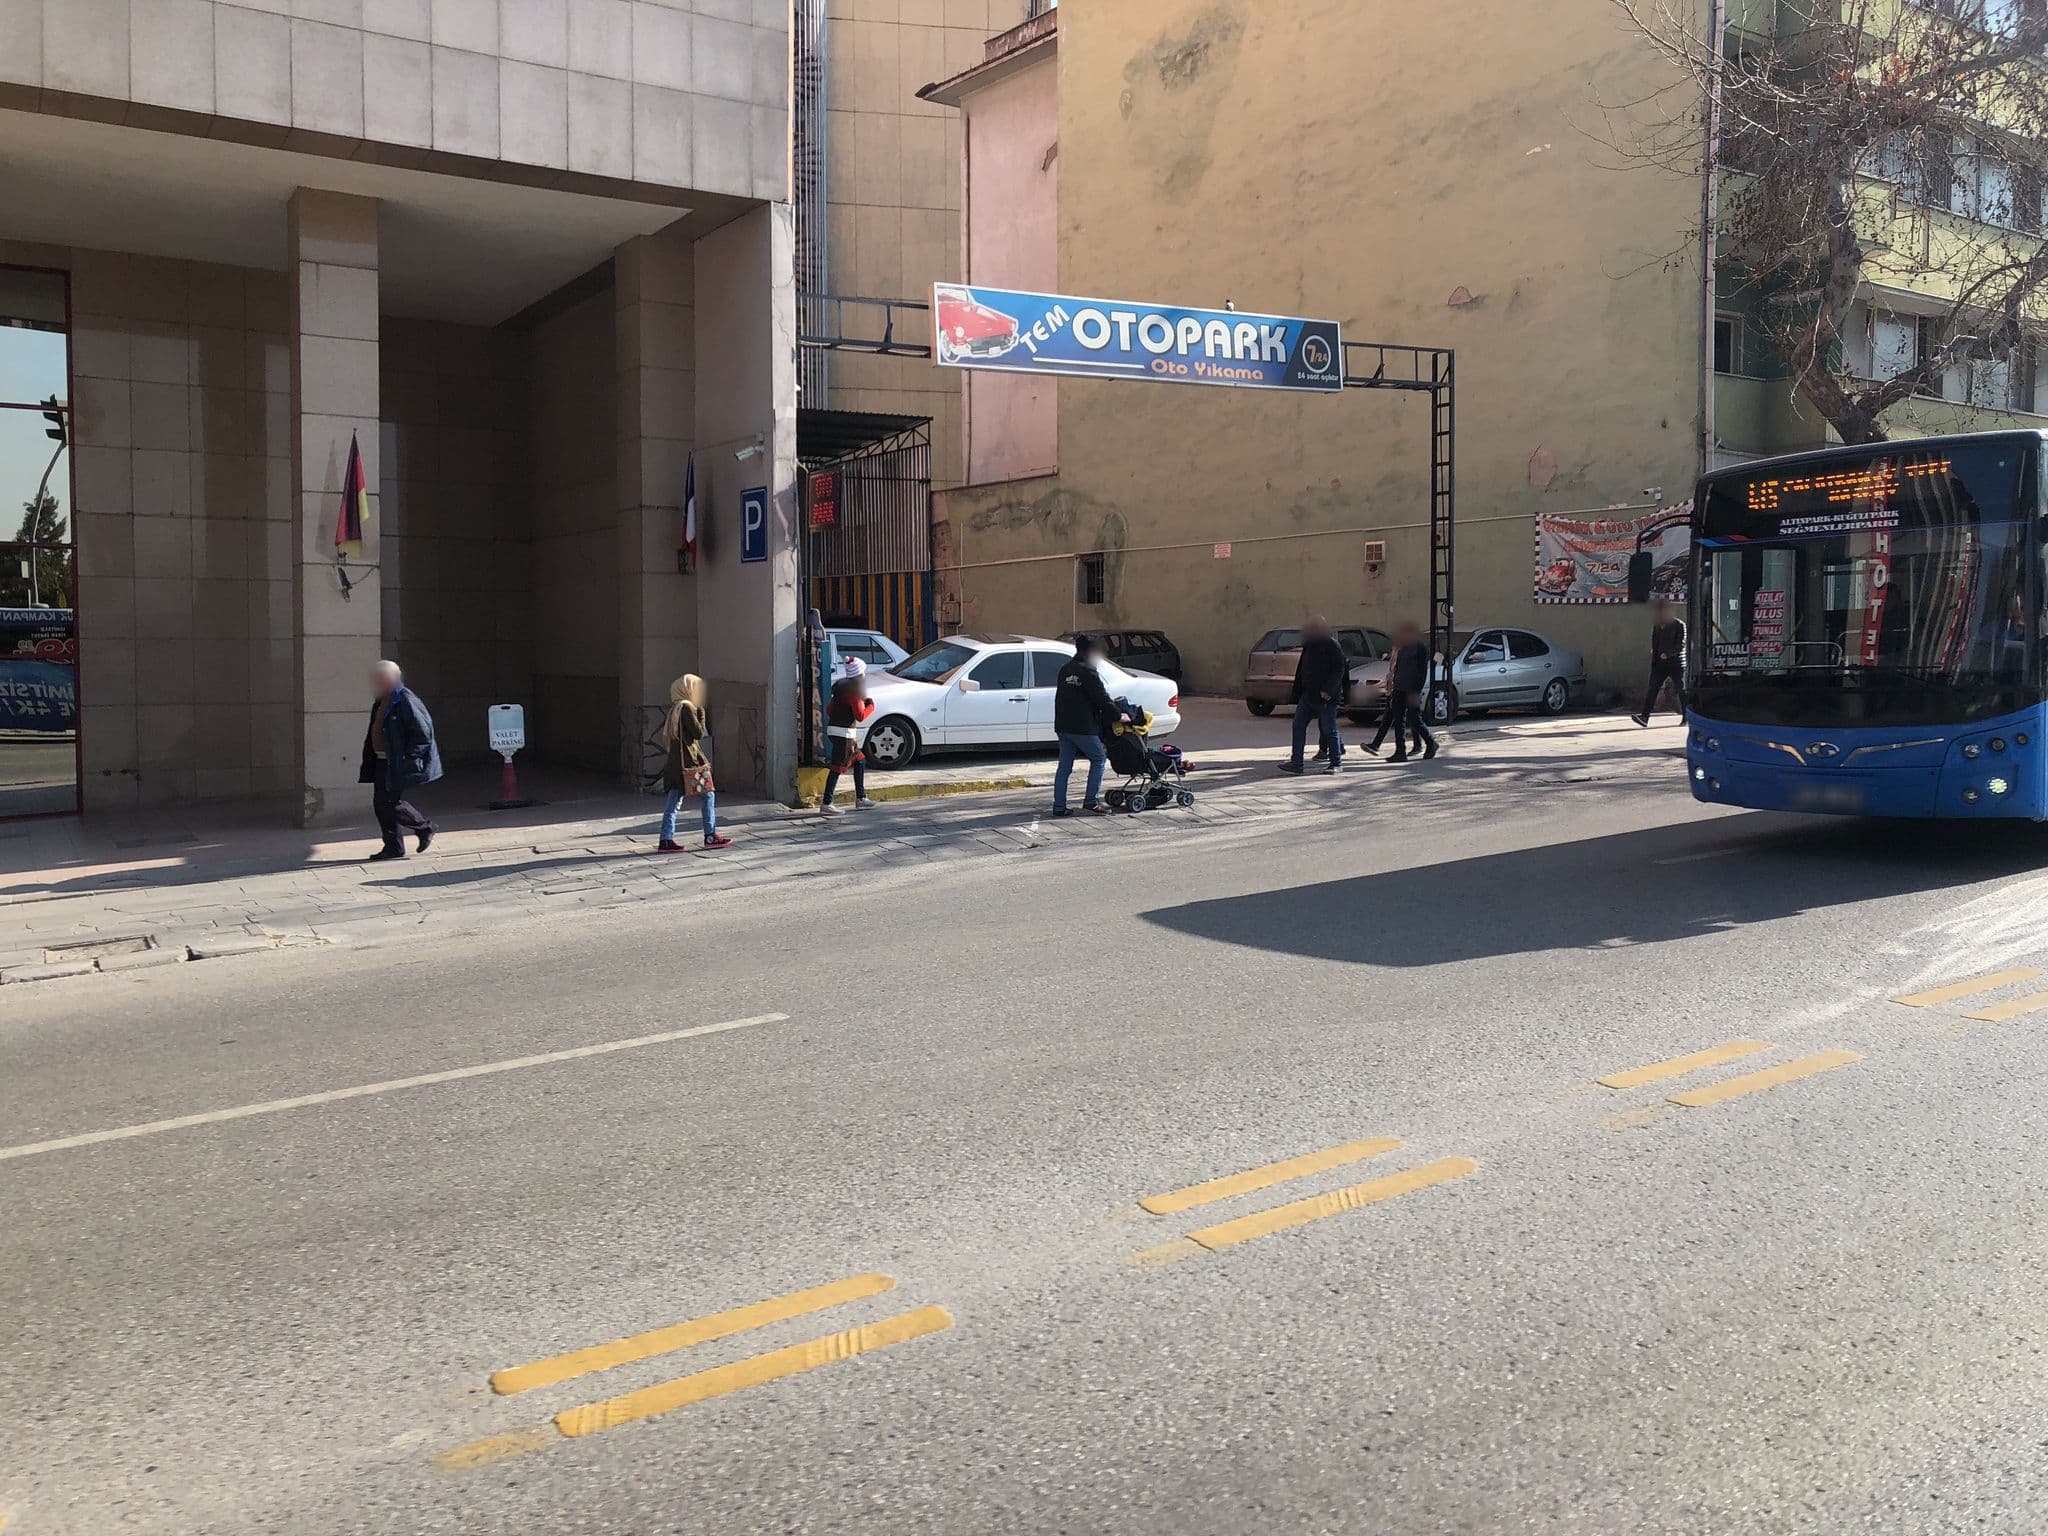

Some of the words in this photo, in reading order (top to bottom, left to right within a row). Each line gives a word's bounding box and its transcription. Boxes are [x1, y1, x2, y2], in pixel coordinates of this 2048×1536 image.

[1020, 304, 1070, 353] TEM
[1072, 308, 1287, 363] OTOPARK
[1306, 343, 1328, 363] 7/24
[1151, 358, 1188, 375] Oto
[1194, 361, 1264, 380] Yıkama
[745, 500, 762, 551] P
[1586, 563, 1621, 574] 7/24
[1755, 609, 1783, 619] ULUS
[1715, 644, 1750, 655] TUNALI
